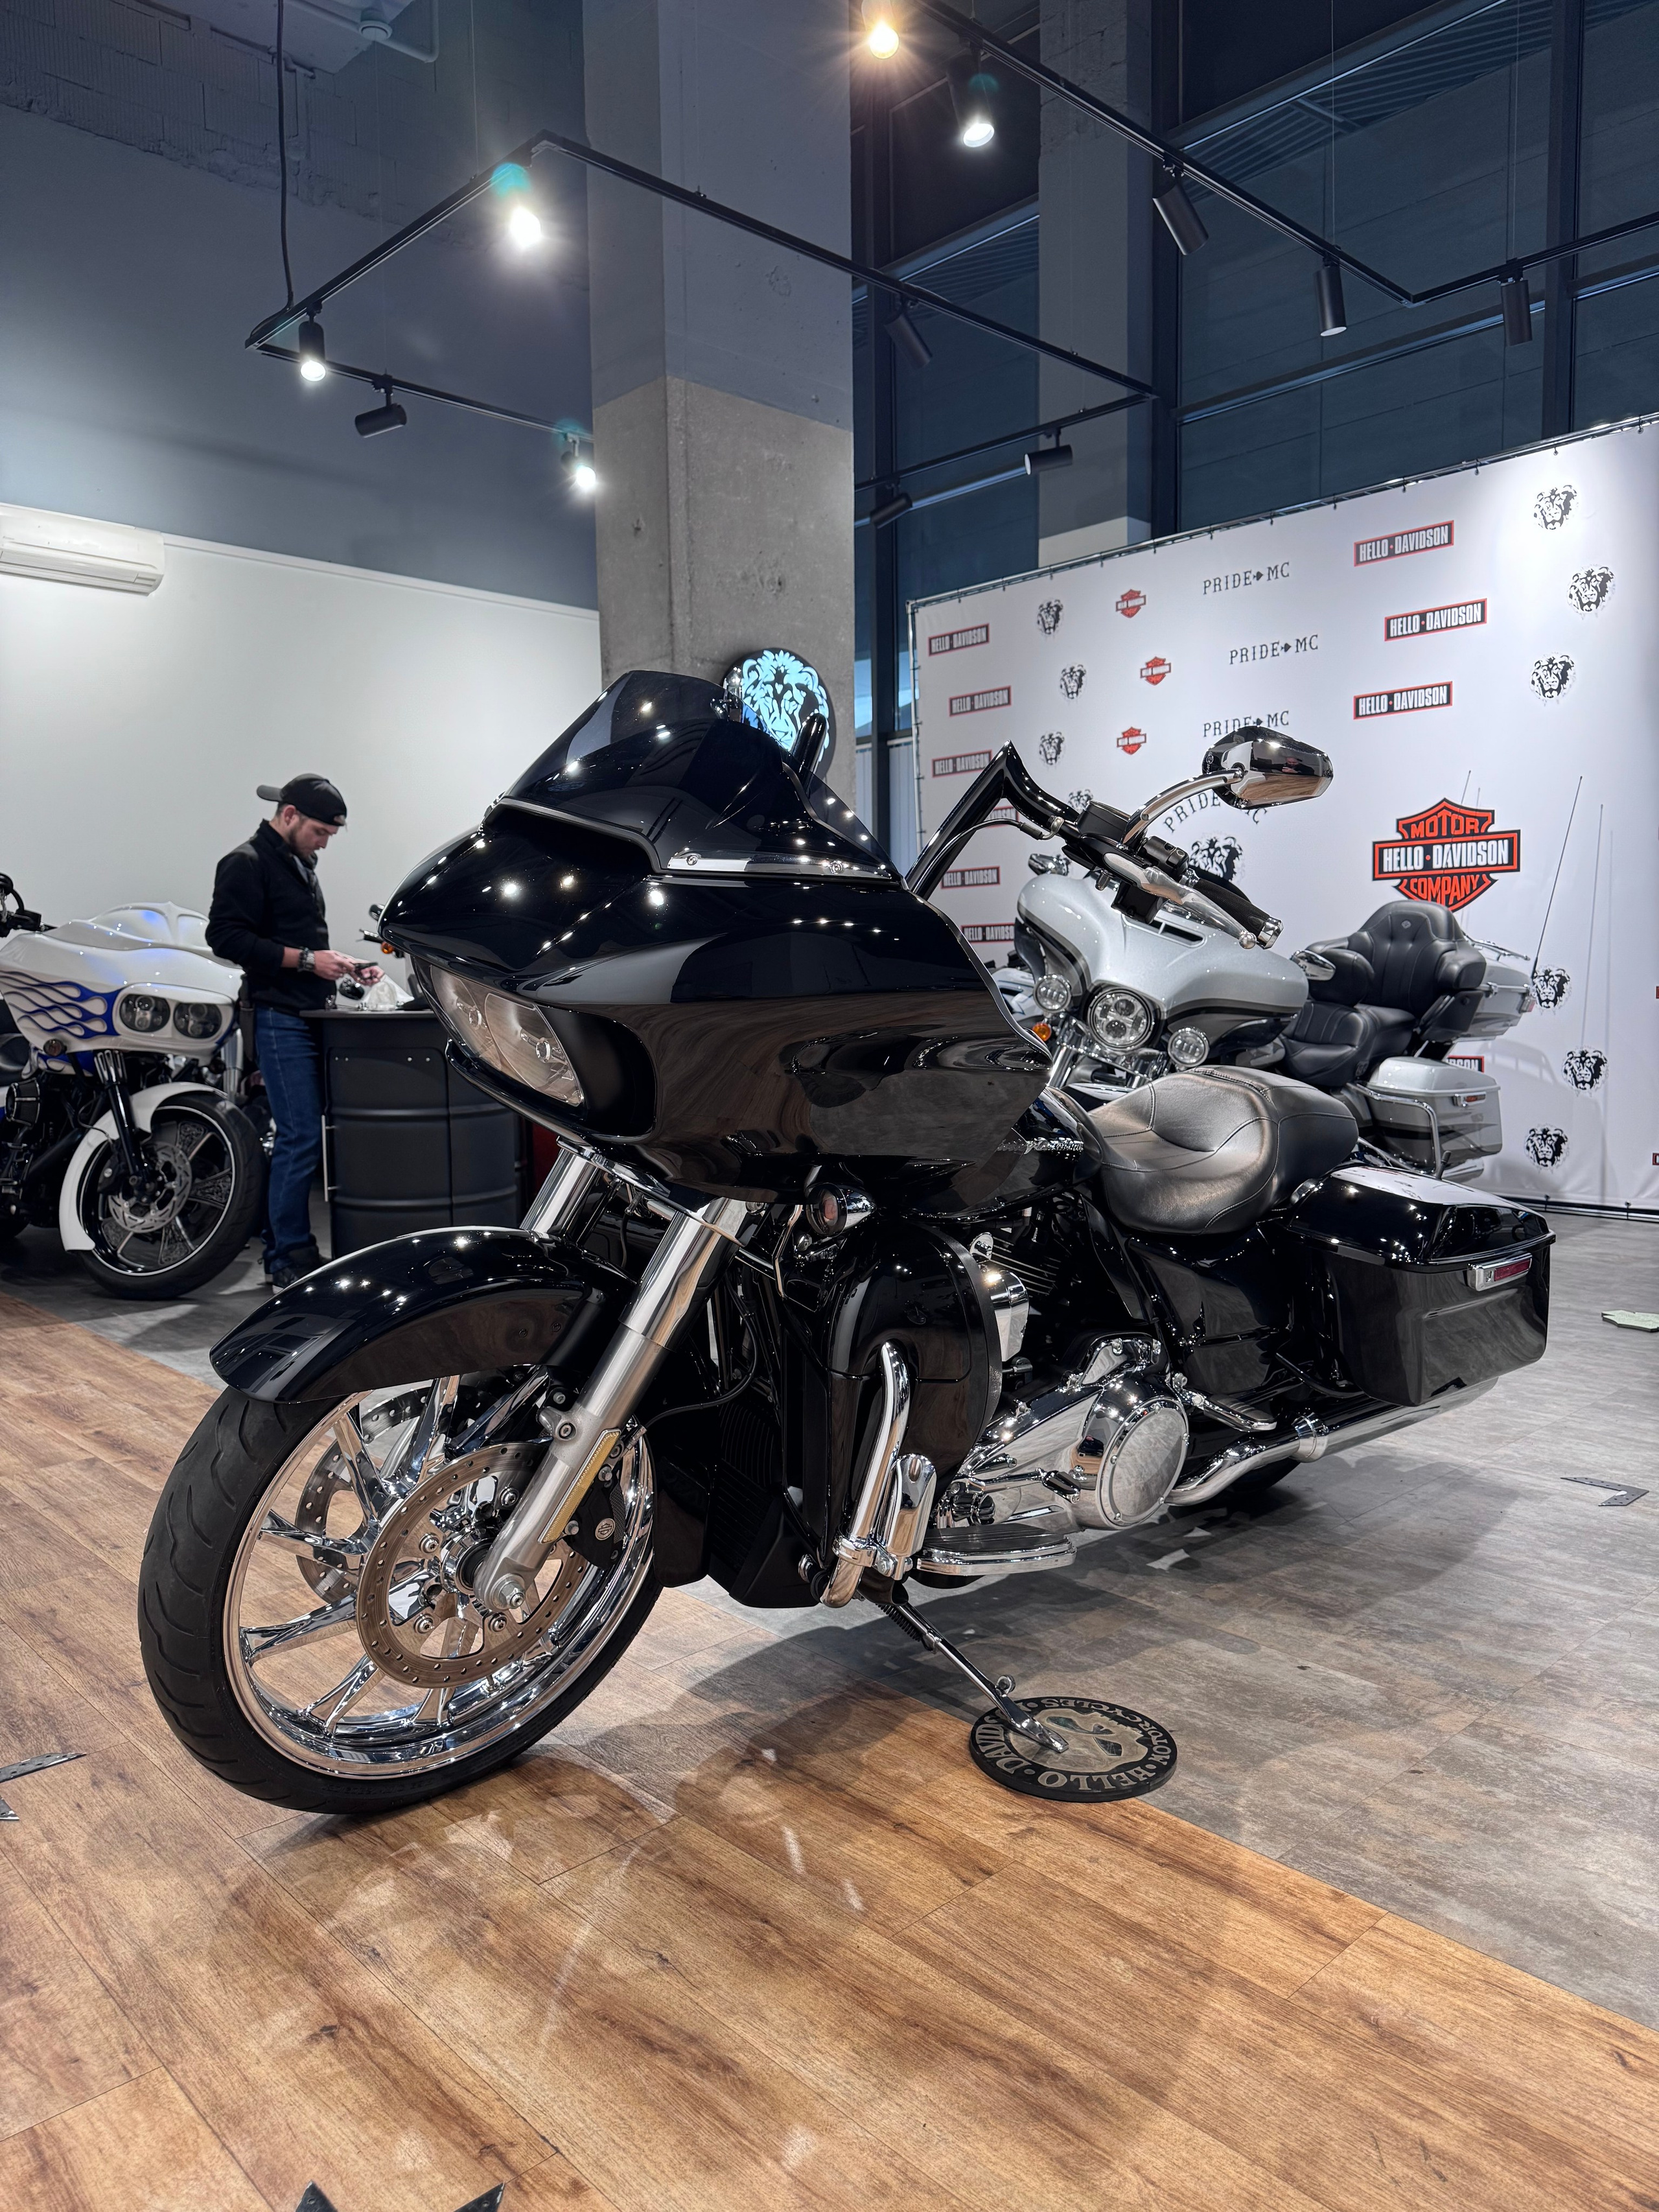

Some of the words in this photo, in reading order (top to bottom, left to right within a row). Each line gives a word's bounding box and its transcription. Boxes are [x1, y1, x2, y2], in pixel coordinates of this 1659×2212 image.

[1359, 539, 1388, 562] HELLO
[1395, 526, 1448, 555] DAVIDSON
[1203, 570, 1252, 595] PRIDE
[1267, 562, 1290, 581] MC
[1389, 615, 1420, 638] HELLO
[1426, 603, 1481, 632] DAVIDSON
[931, 635, 950, 653] HELLO
[953, 627, 987, 649] DAVIDSON
[1229, 640, 1280, 665] PRIDE
[1295, 634, 1318, 653] MC
[952, 696, 971, 714] HELLO
[974, 688, 1008, 710] DAVIDSON
[1358, 694, 1388, 716] HELLO
[1393, 685, 1447, 710] DAVIDSON
[1267, 710, 1289, 728] MC
[935, 758, 953, 775] HELLO
[1163, 792, 1221, 833] PRIDE
[1410, 809, 1479, 839] MOTOR
[1383, 846, 1424, 872] HELLO
[1432, 839, 1509, 869] DAVIDSON
[943, 872, 962, 887] HELLO
[964, 868, 997, 885] DAVIDSON
[1410, 874, 1479, 906] COMPANY
[986, 925, 1014, 941] DAVIDSO
[1041, 1698, 1172, 1765] MOTORCYCLES
[1038, 1765, 1156, 1791] HELLO
